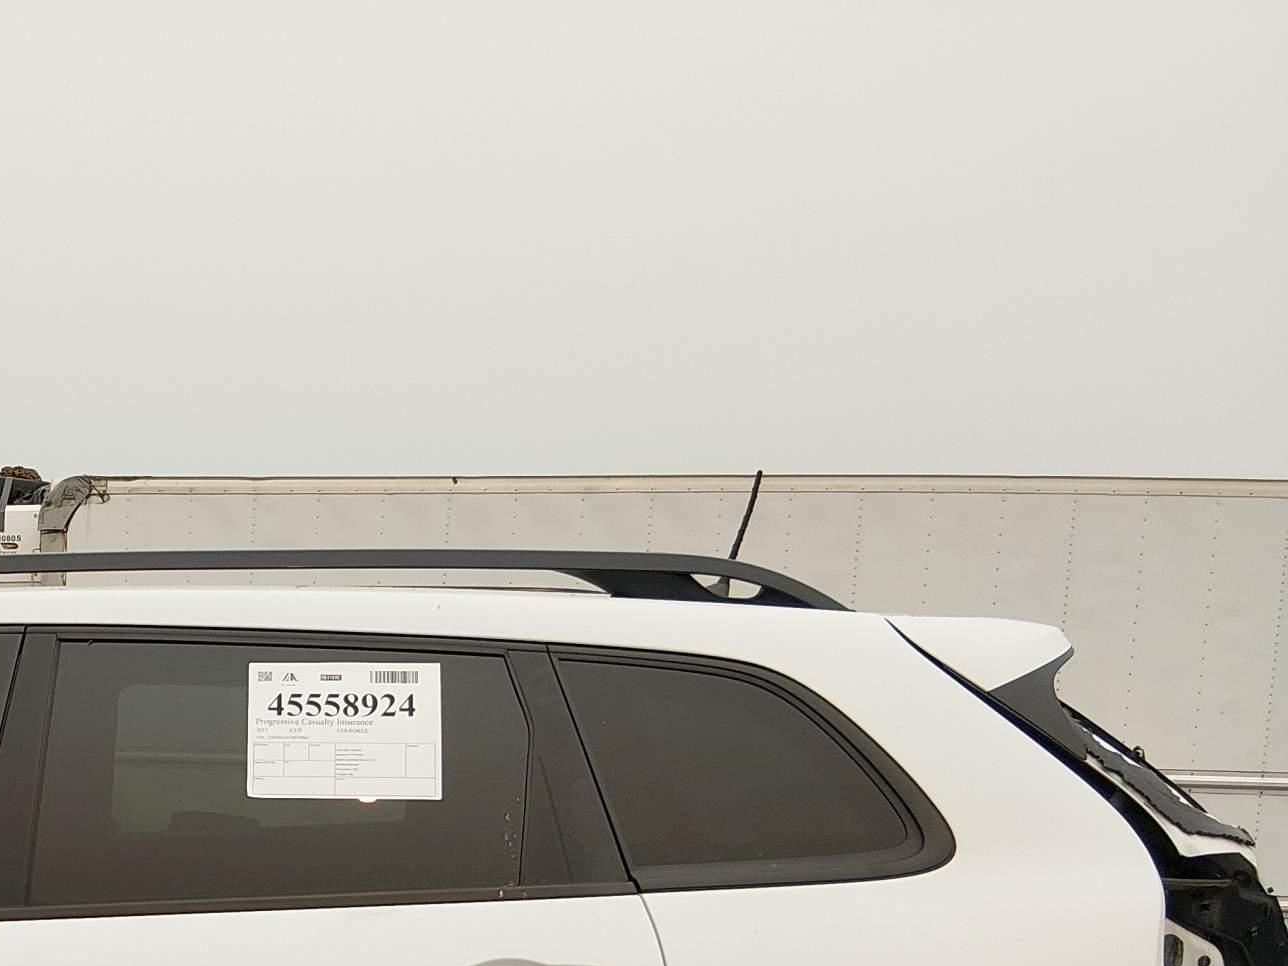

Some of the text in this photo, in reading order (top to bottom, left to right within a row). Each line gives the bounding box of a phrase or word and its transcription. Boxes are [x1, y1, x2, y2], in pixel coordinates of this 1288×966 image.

[267, 693, 416, 717] 45558924
[255, 718, 374, 727] Progressive Casualty Insurance
